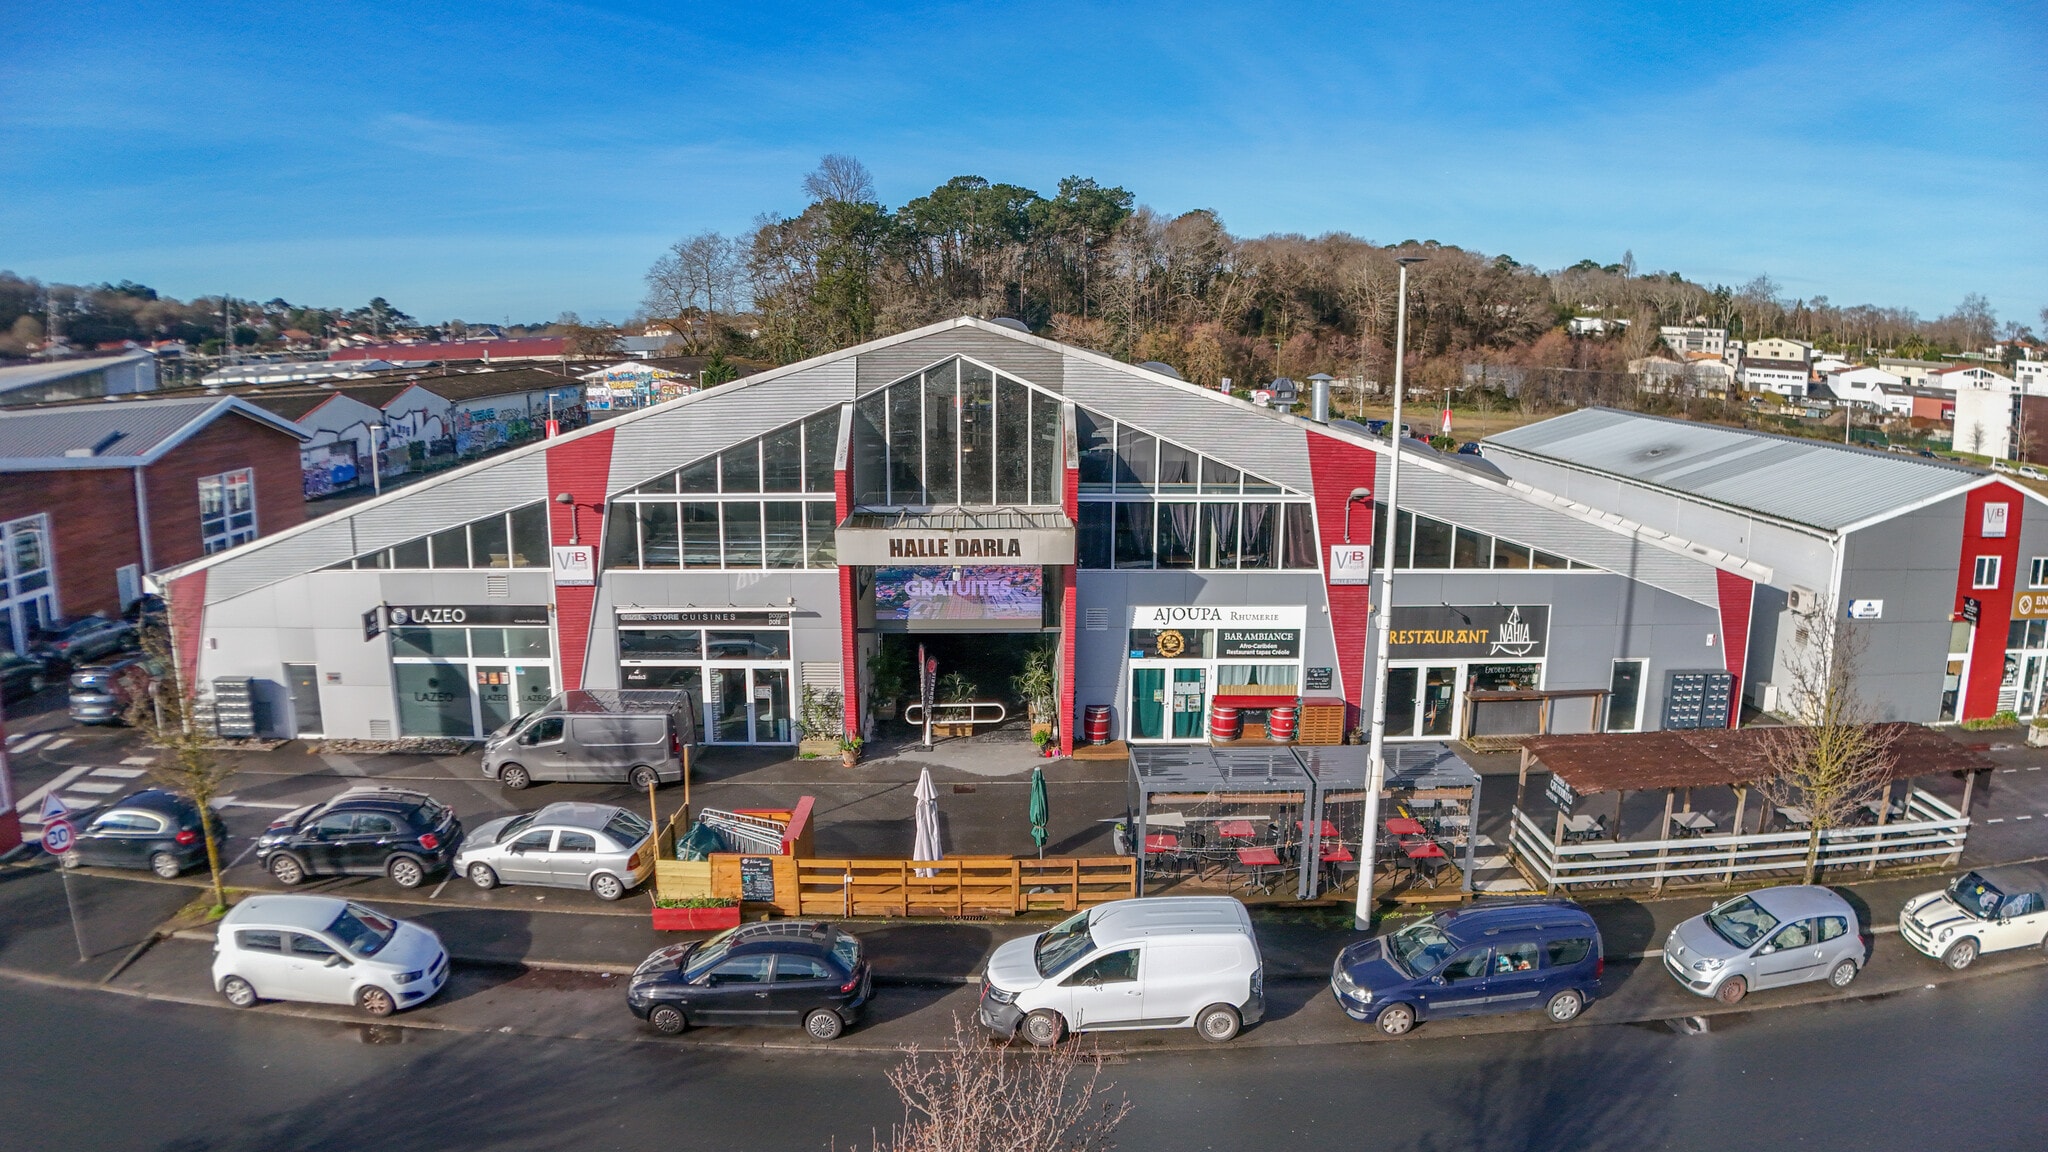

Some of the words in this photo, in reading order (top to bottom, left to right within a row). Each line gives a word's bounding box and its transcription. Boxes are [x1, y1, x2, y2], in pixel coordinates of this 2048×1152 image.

[889, 538, 949, 558] HALLE
[955, 538, 1021, 558] DARLA
[904, 580, 1012, 597] GRATUITES
[411, 608, 466, 623] LAZEO
[681, 612, 736, 621] CUISINES
[1153, 607, 1222, 625] AJOUPA
[1224, 633, 1242, 641] BAR
[1244, 632, 1294, 641] AMBIANCE
[1389, 630, 1489, 644] RESTAURANT
[1500, 623, 1529, 642] NAHIA
[414, 692, 454, 702] LAZEO
[47, 828, 68, 846] 30
